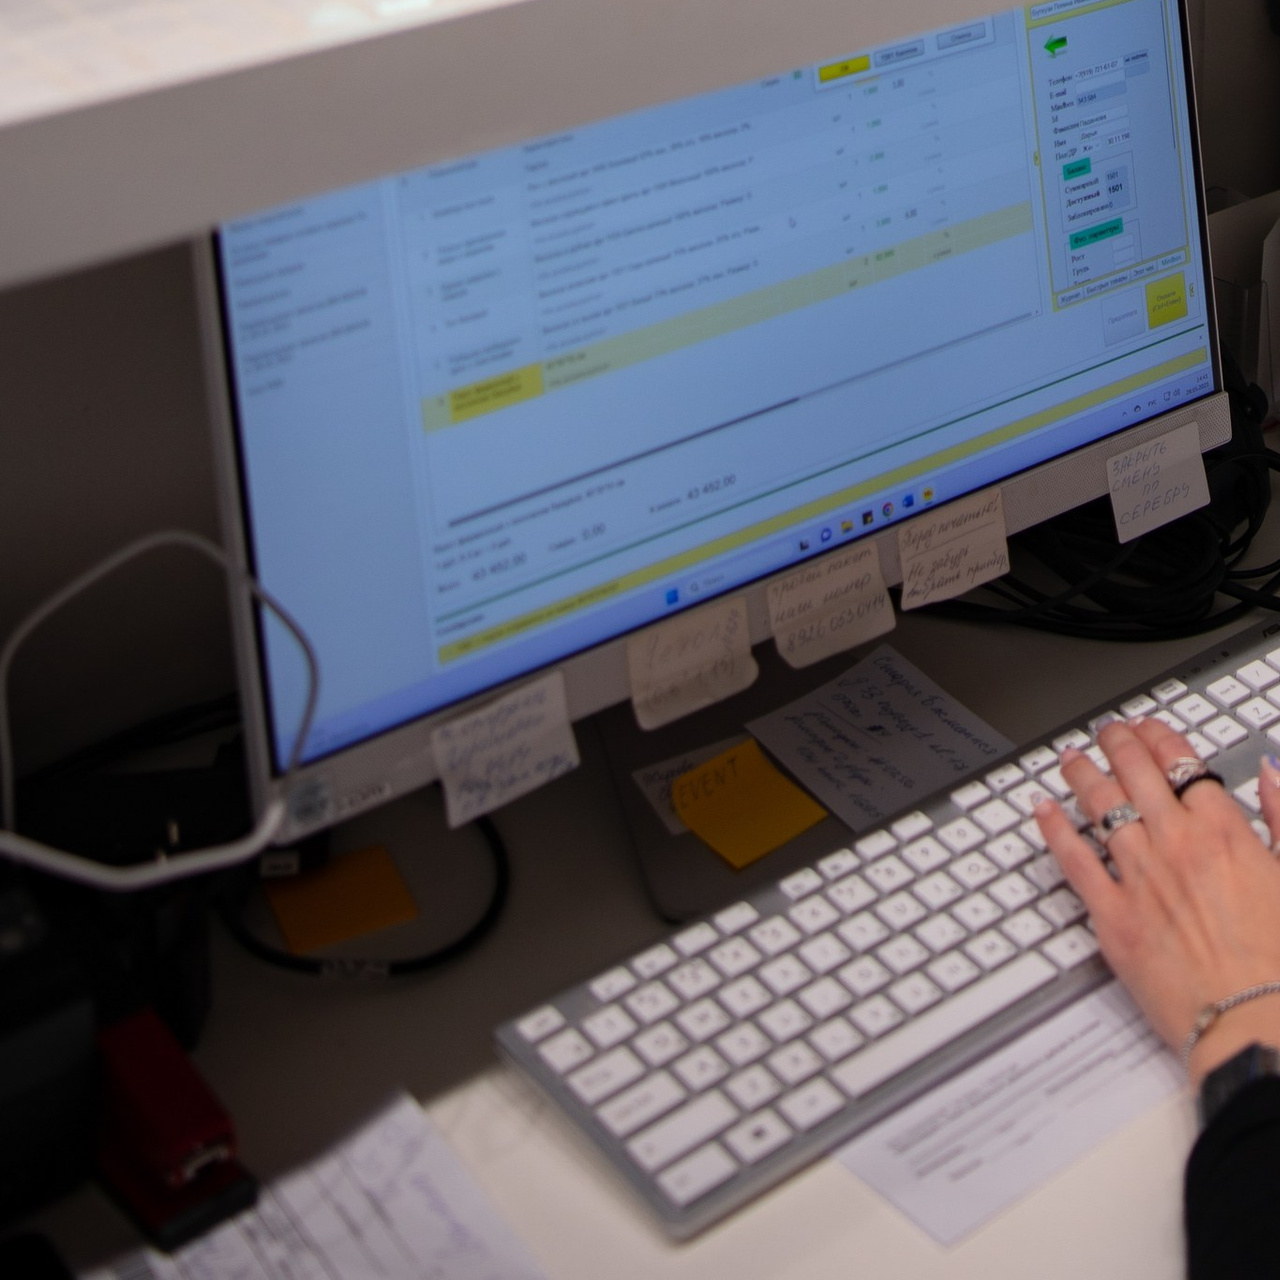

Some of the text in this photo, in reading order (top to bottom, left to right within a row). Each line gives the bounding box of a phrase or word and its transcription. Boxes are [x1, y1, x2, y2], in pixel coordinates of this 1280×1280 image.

[1050, 89, 1067, 99] E-mail
[1066, 183, 1123, 208] Доступный 1501
[678, 756, 739, 811] EVENT
